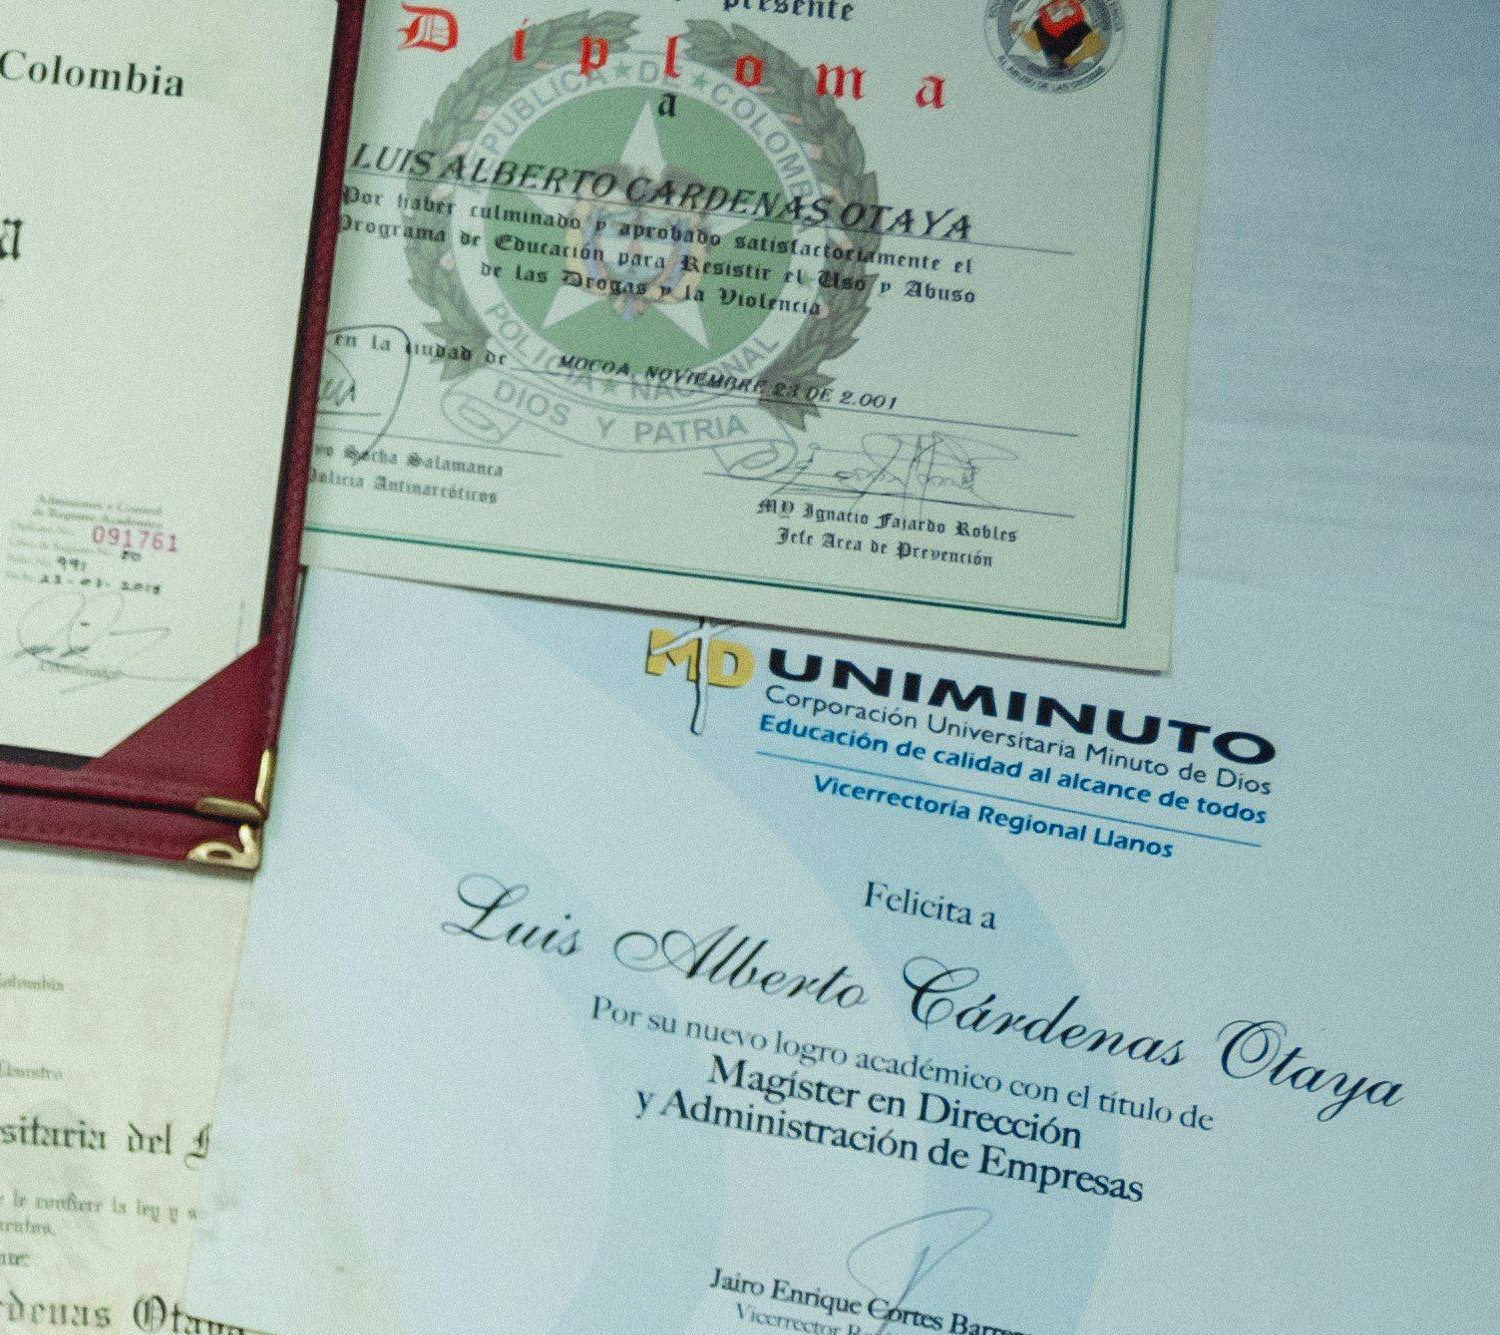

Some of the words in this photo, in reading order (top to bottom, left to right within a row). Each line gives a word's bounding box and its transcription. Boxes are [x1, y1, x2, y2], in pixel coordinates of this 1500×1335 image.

[351, 143, 434, 176] LUIS
[443, 155, 618, 200] ALBERTO
[625, 174, 837, 224] CARDENAS
[842, 202, 973, 241] OTAYA
[92, 526, 179, 554] 091761
[765, 685, 921, 733] Corporación
[925, 706, 1078, 762] Universitaria
[1085, 742, 1172, 778] Minuto
[1177, 762, 1208, 787] de
[1217, 766, 1273, 795] Dios
[768, 649, 1277, 766] UNIMINUTO
[977, 804, 1091, 844] Regional
[1098, 826, 1175, 861] Llanos
[440, 874, 584, 959] Luis
[613, 925, 871, 1013] Alberto
[898, 955, 1190, 1069] Cárdenas
[1215, 1018, 1406, 1121] Otaya
